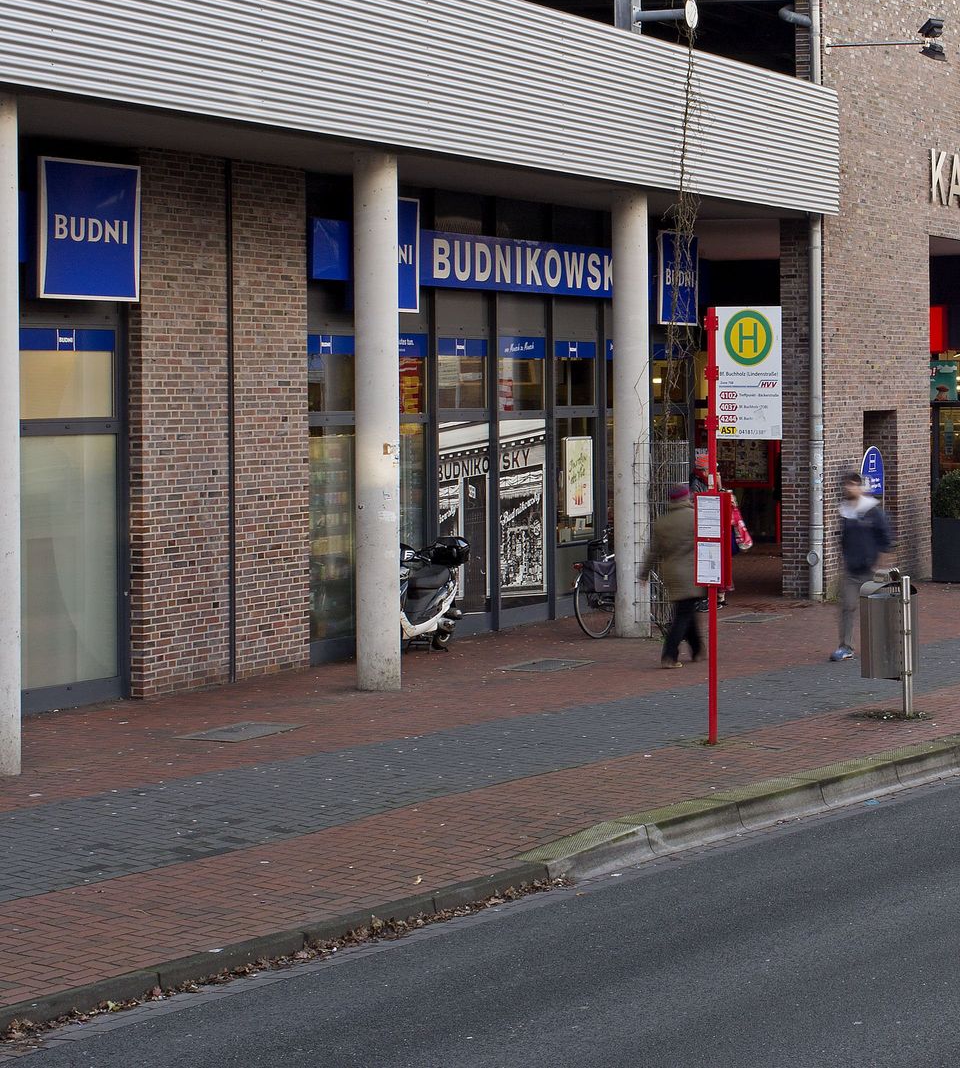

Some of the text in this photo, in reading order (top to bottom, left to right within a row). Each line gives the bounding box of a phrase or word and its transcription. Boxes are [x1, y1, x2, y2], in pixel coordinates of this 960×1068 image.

[54, 213, 109, 245] BUDNI
[738, 322, 758, 353] H
[760, 381, 778, 389] HVV
[720, 391, 737, 399] 4102
[720, 403, 737, 411] 4037
[720, 415, 737, 423] 4244
[720, 426, 736, 434] AST
